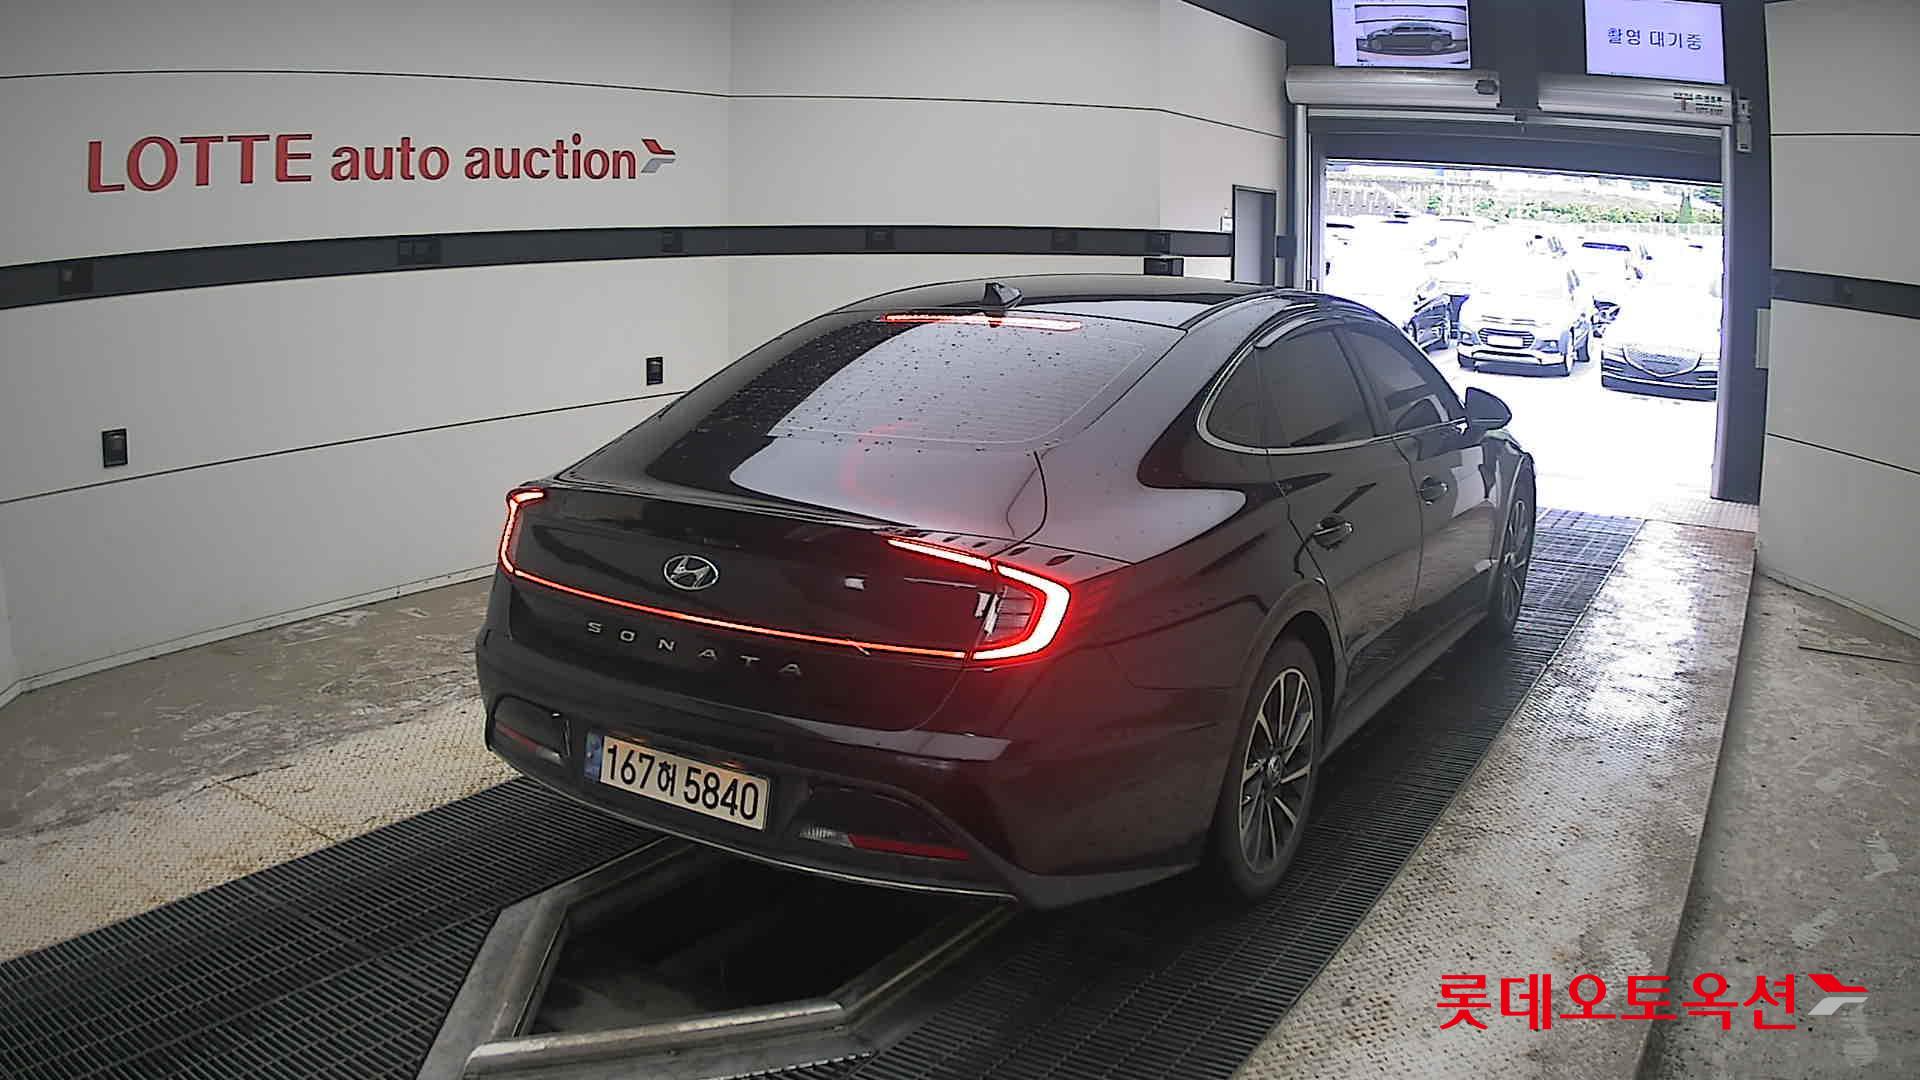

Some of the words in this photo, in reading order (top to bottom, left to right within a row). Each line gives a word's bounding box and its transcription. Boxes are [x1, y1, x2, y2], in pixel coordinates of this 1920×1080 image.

[1608, 27, 1642, 46] 촬영
[88, 133, 313, 193] LOTTE
[330, 136, 450, 181] auto
[463, 132, 637, 180] auction
[587, 621, 803, 677] SONATA
[607, 743, 677, 797] 167허
[683, 765, 760, 821] 5840
